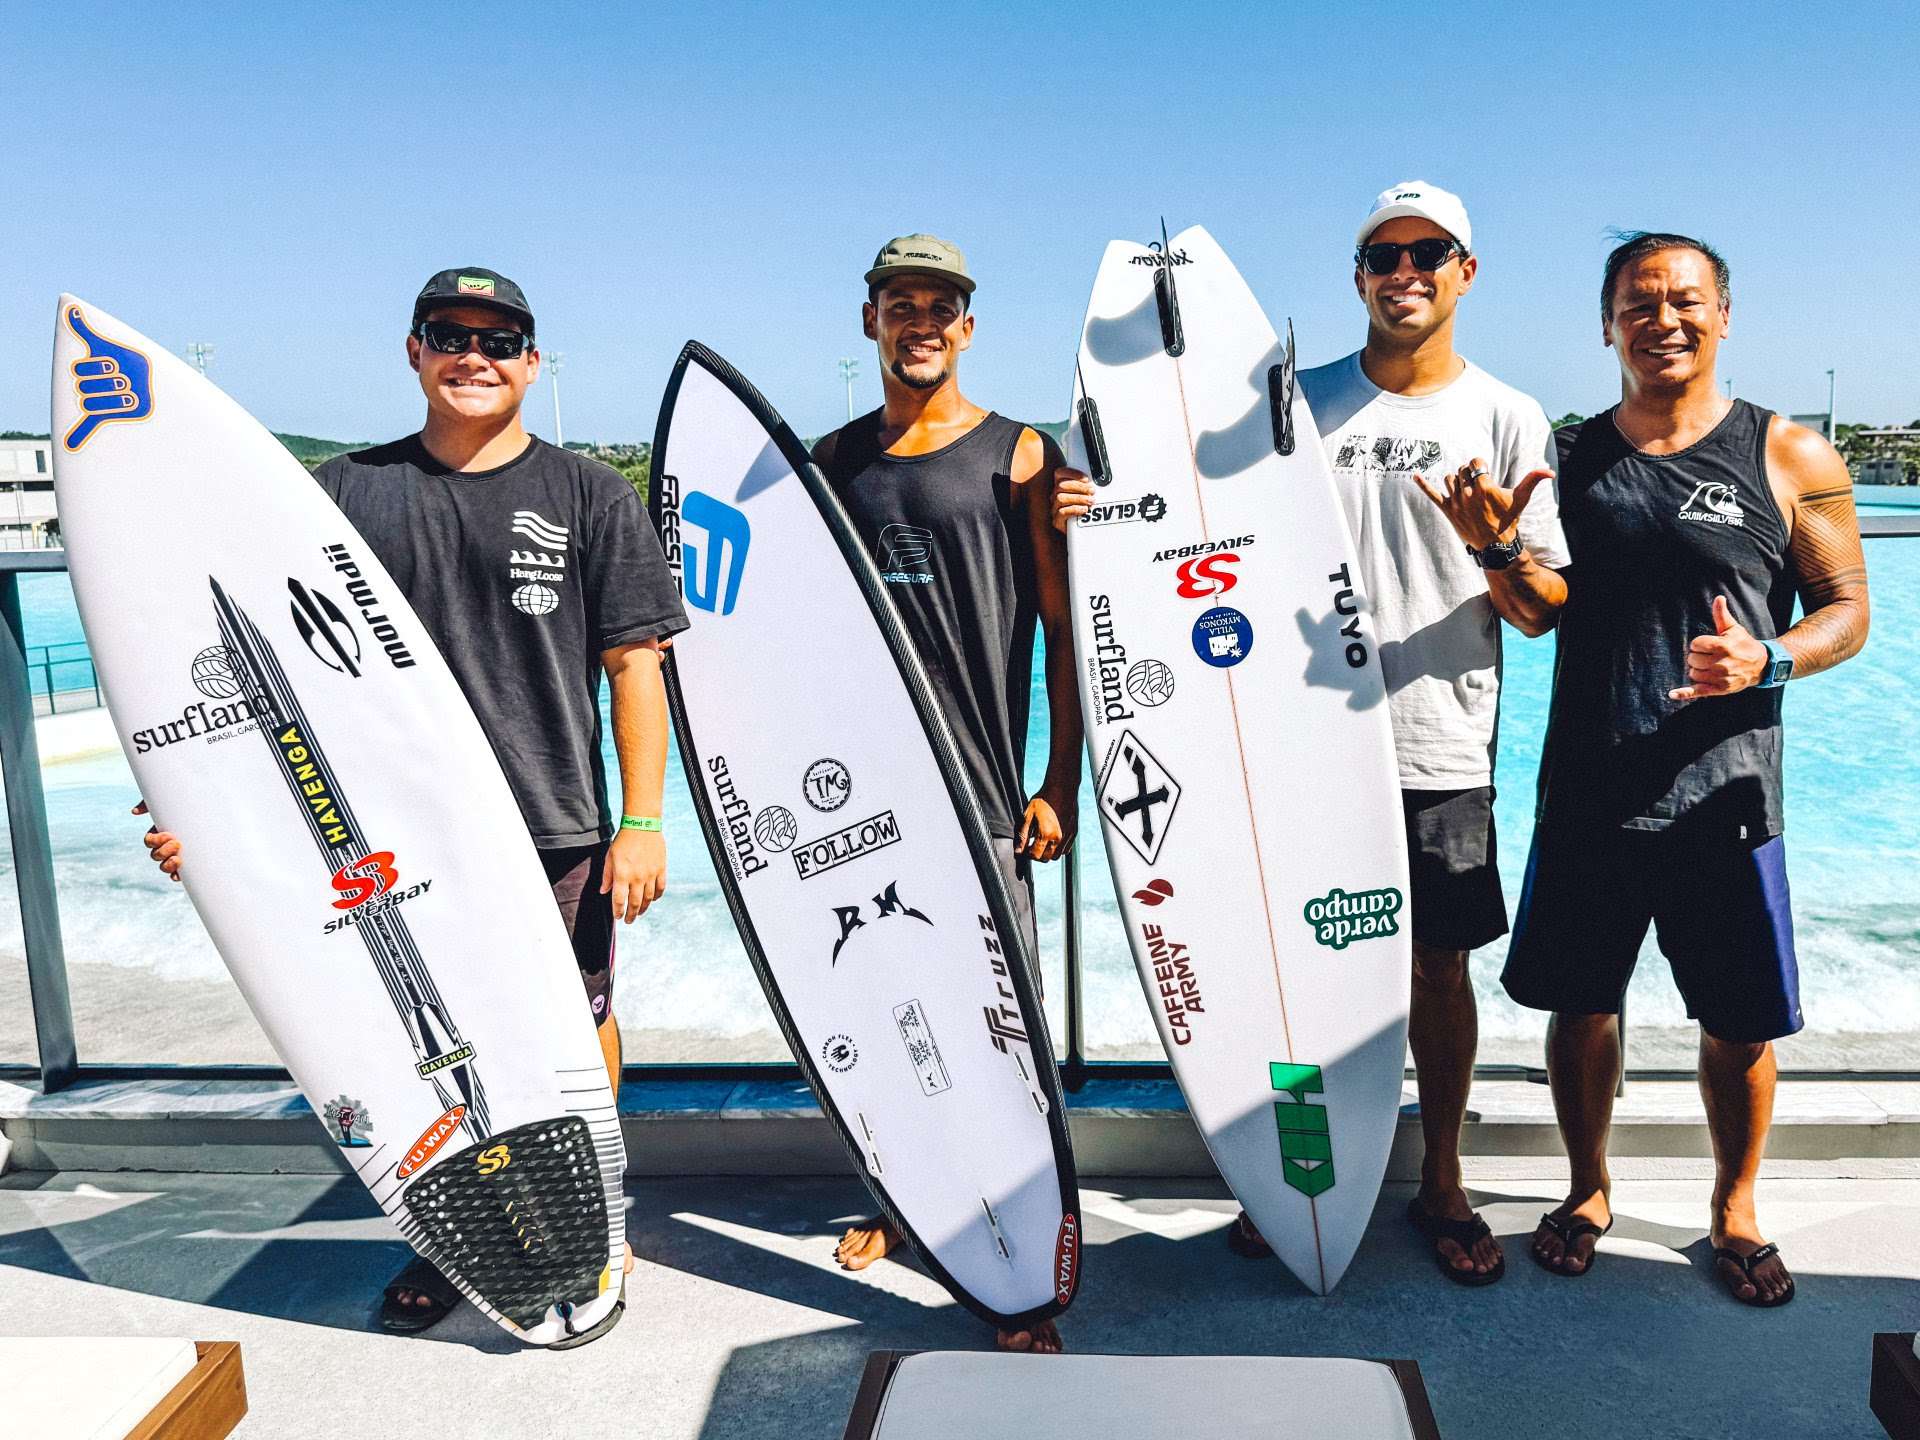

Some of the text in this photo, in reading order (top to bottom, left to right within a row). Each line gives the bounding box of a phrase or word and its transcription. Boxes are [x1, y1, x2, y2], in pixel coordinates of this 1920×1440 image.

[880, 572, 934, 584] REESURF
[1200, 615, 1241, 629] MYKONOS
[1209, 626, 1234, 636] VILLA
[1328, 562, 1367, 668] TUYO
[1089, 594, 1134, 724] surfland
[132, 685, 279, 754] surfland
[279, 726, 348, 844] HAVENGA
[708, 755, 768, 878] surfland
[795, 816, 896, 873] FOLLOW
[1309, 893, 1398, 920] campo
[1320, 914, 1393, 945] verde
[1142, 923, 1191, 1045] CAFFEINE
[1168, 943, 1205, 1012] ARMY
[421, 1047, 473, 1075] HAVENGA
